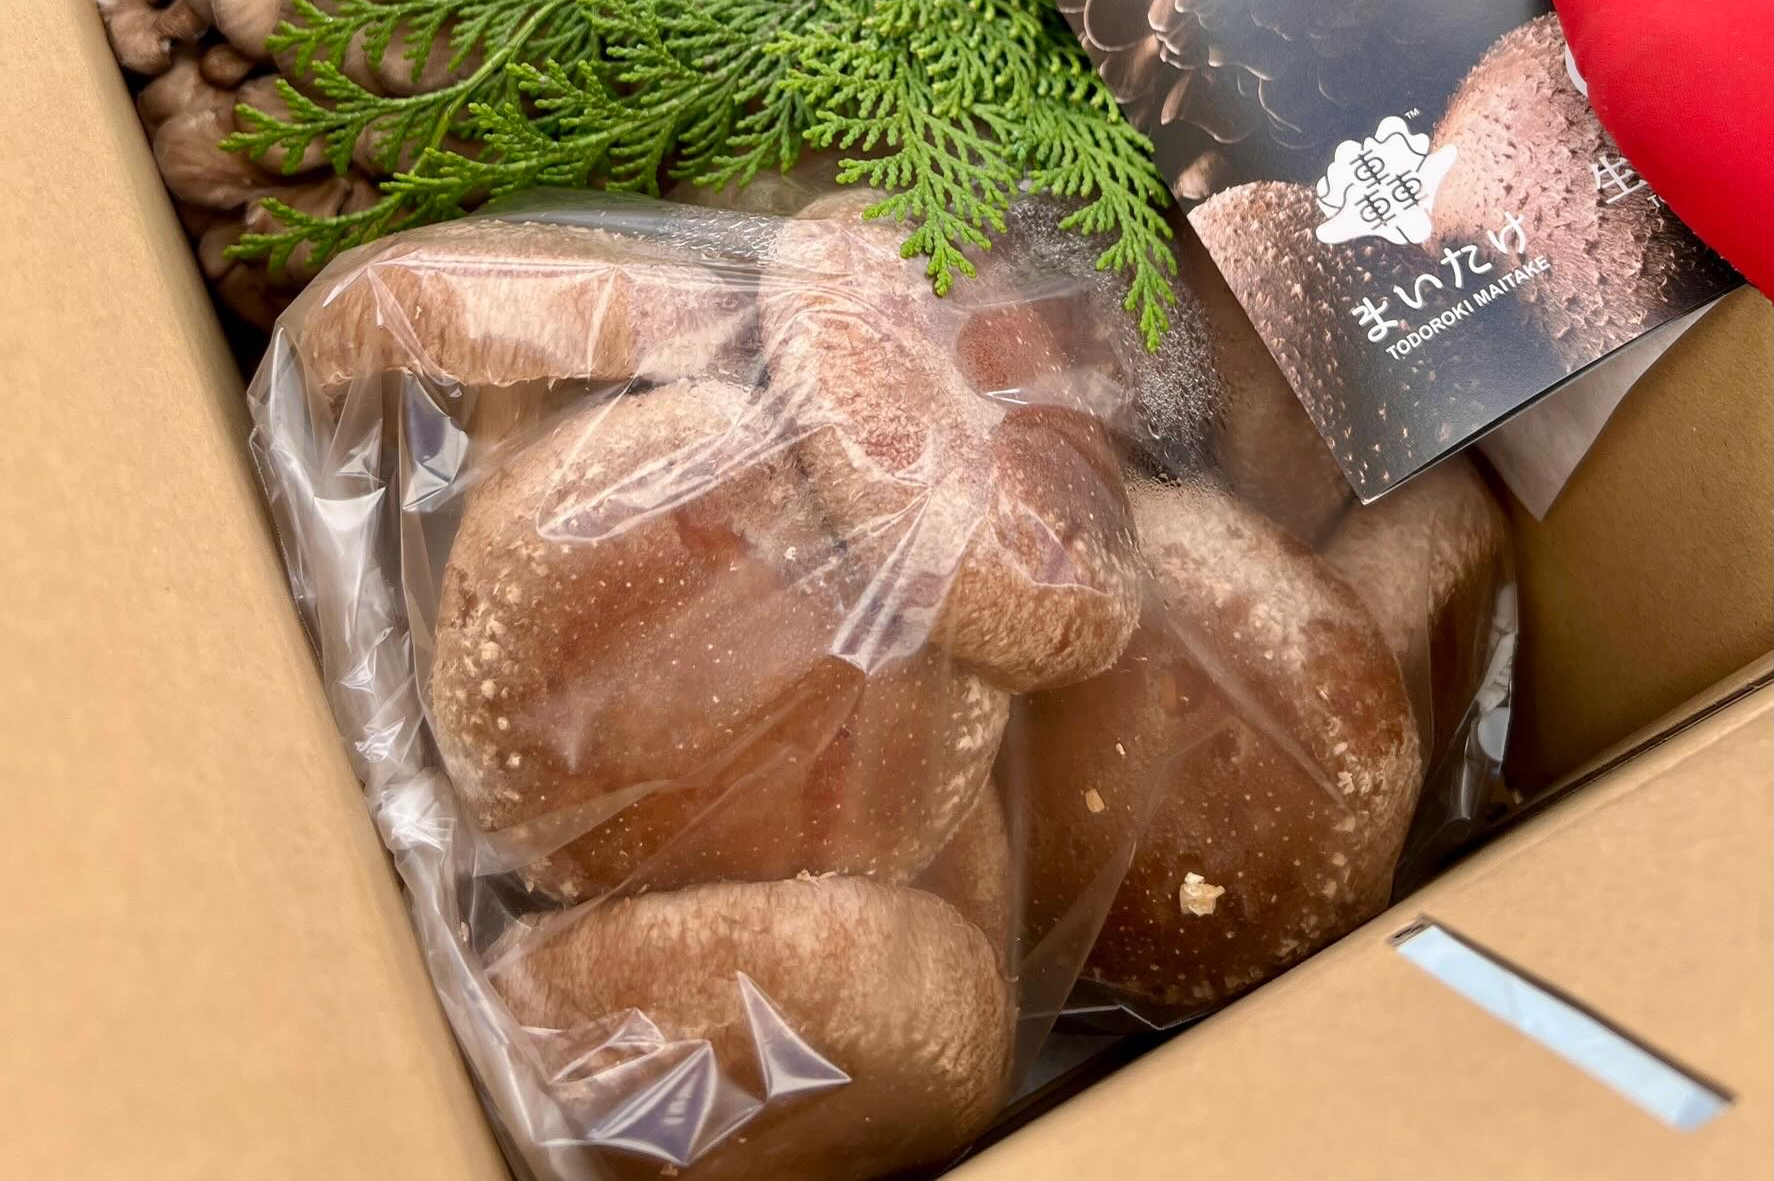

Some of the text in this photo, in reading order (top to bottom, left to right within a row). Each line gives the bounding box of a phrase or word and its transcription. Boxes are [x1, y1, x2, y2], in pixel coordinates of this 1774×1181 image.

[1351, 210, 1527, 343] まいたけ
[1385, 255, 1551, 361] TODOROKI MAITAKE
